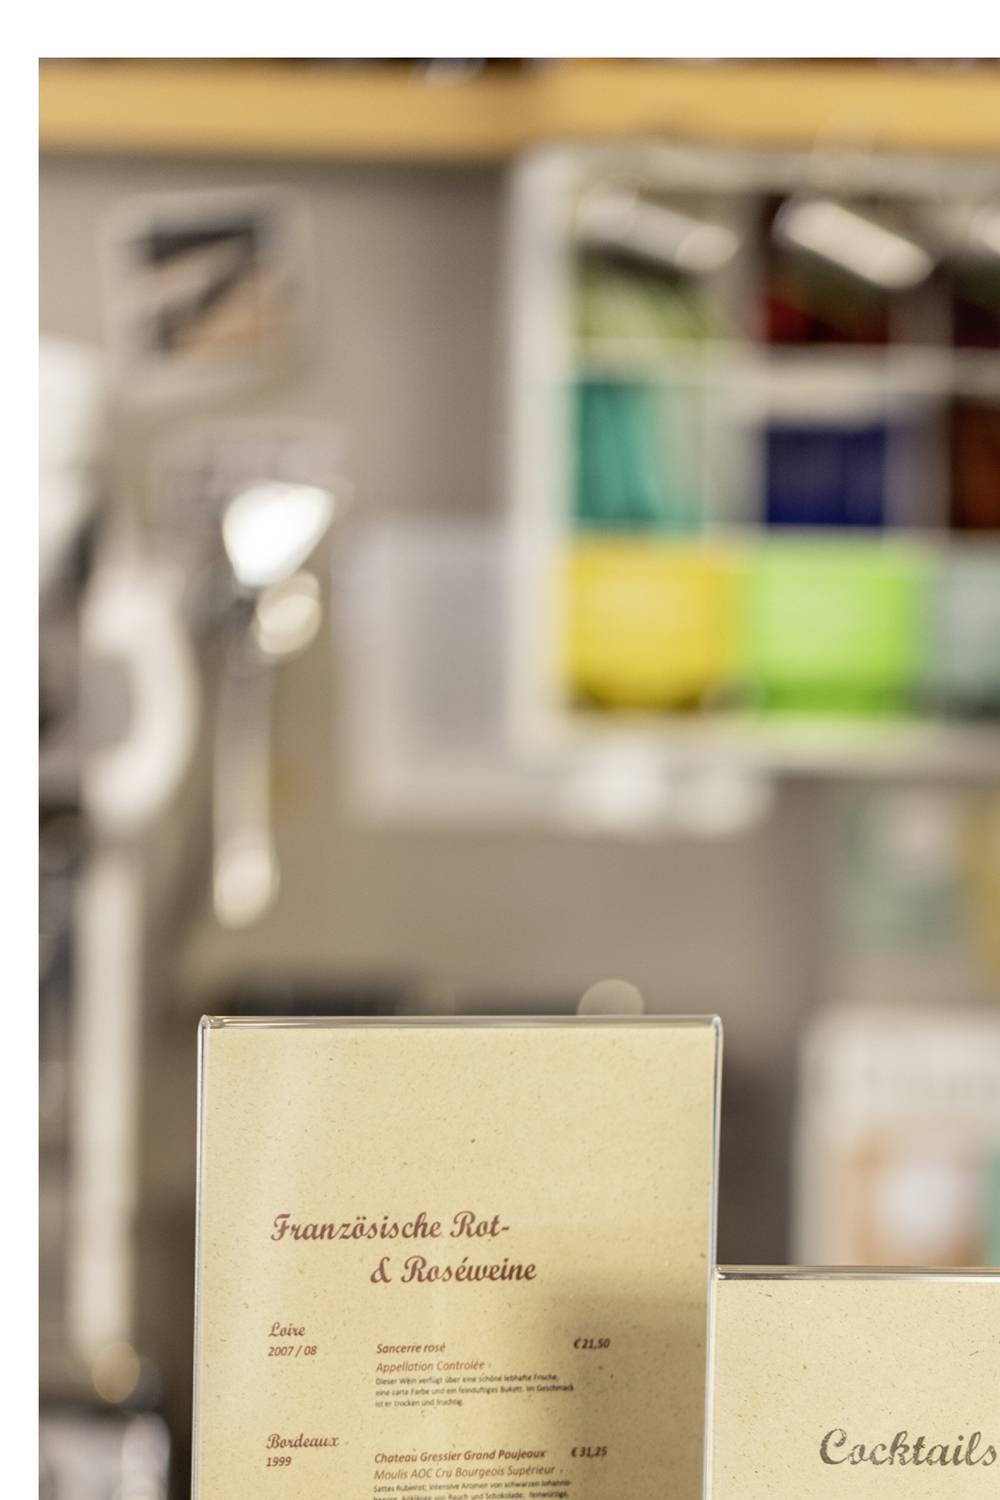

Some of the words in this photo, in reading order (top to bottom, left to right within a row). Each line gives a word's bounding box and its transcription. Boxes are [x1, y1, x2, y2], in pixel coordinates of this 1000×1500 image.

[270, 1211, 441, 1240] Französische
[449, 1210, 510, 1238] Rot-
[369, 1256, 392, 1283] &
[400, 1253, 536, 1283] Roséweine
[268, 1322, 305, 1336] Loire
[267, 1345, 294, 1356] 2007
[302, 1344, 318, 1355] 08
[375, 1342, 422, 1354] Sancerre
[422, 1342, 446, 1352] rosé
[375, 1361, 433, 1373] Appellation
[436, 1359, 485, 1370] Controlée
[265, 1433, 339, 1448] Bordeaux
[818, 1428, 996, 1466] Cocktails
[265, 1456, 292, 1467] 1999
[373, 1452, 418, 1463] Chateau
[419, 1450, 461, 1462] Gressier
[462, 1449, 496, 1460] Grand
[497, 1448, 545, 1460] Poujeaux
[372, 1469, 408, 1479] Moulis
[410, 1468, 432, 1478] AOC
[434, 1467, 452, 1478] Cru
[454, 1465, 505, 1478] Bourgeois
[506, 1464, 555, 1476] Supérieur
